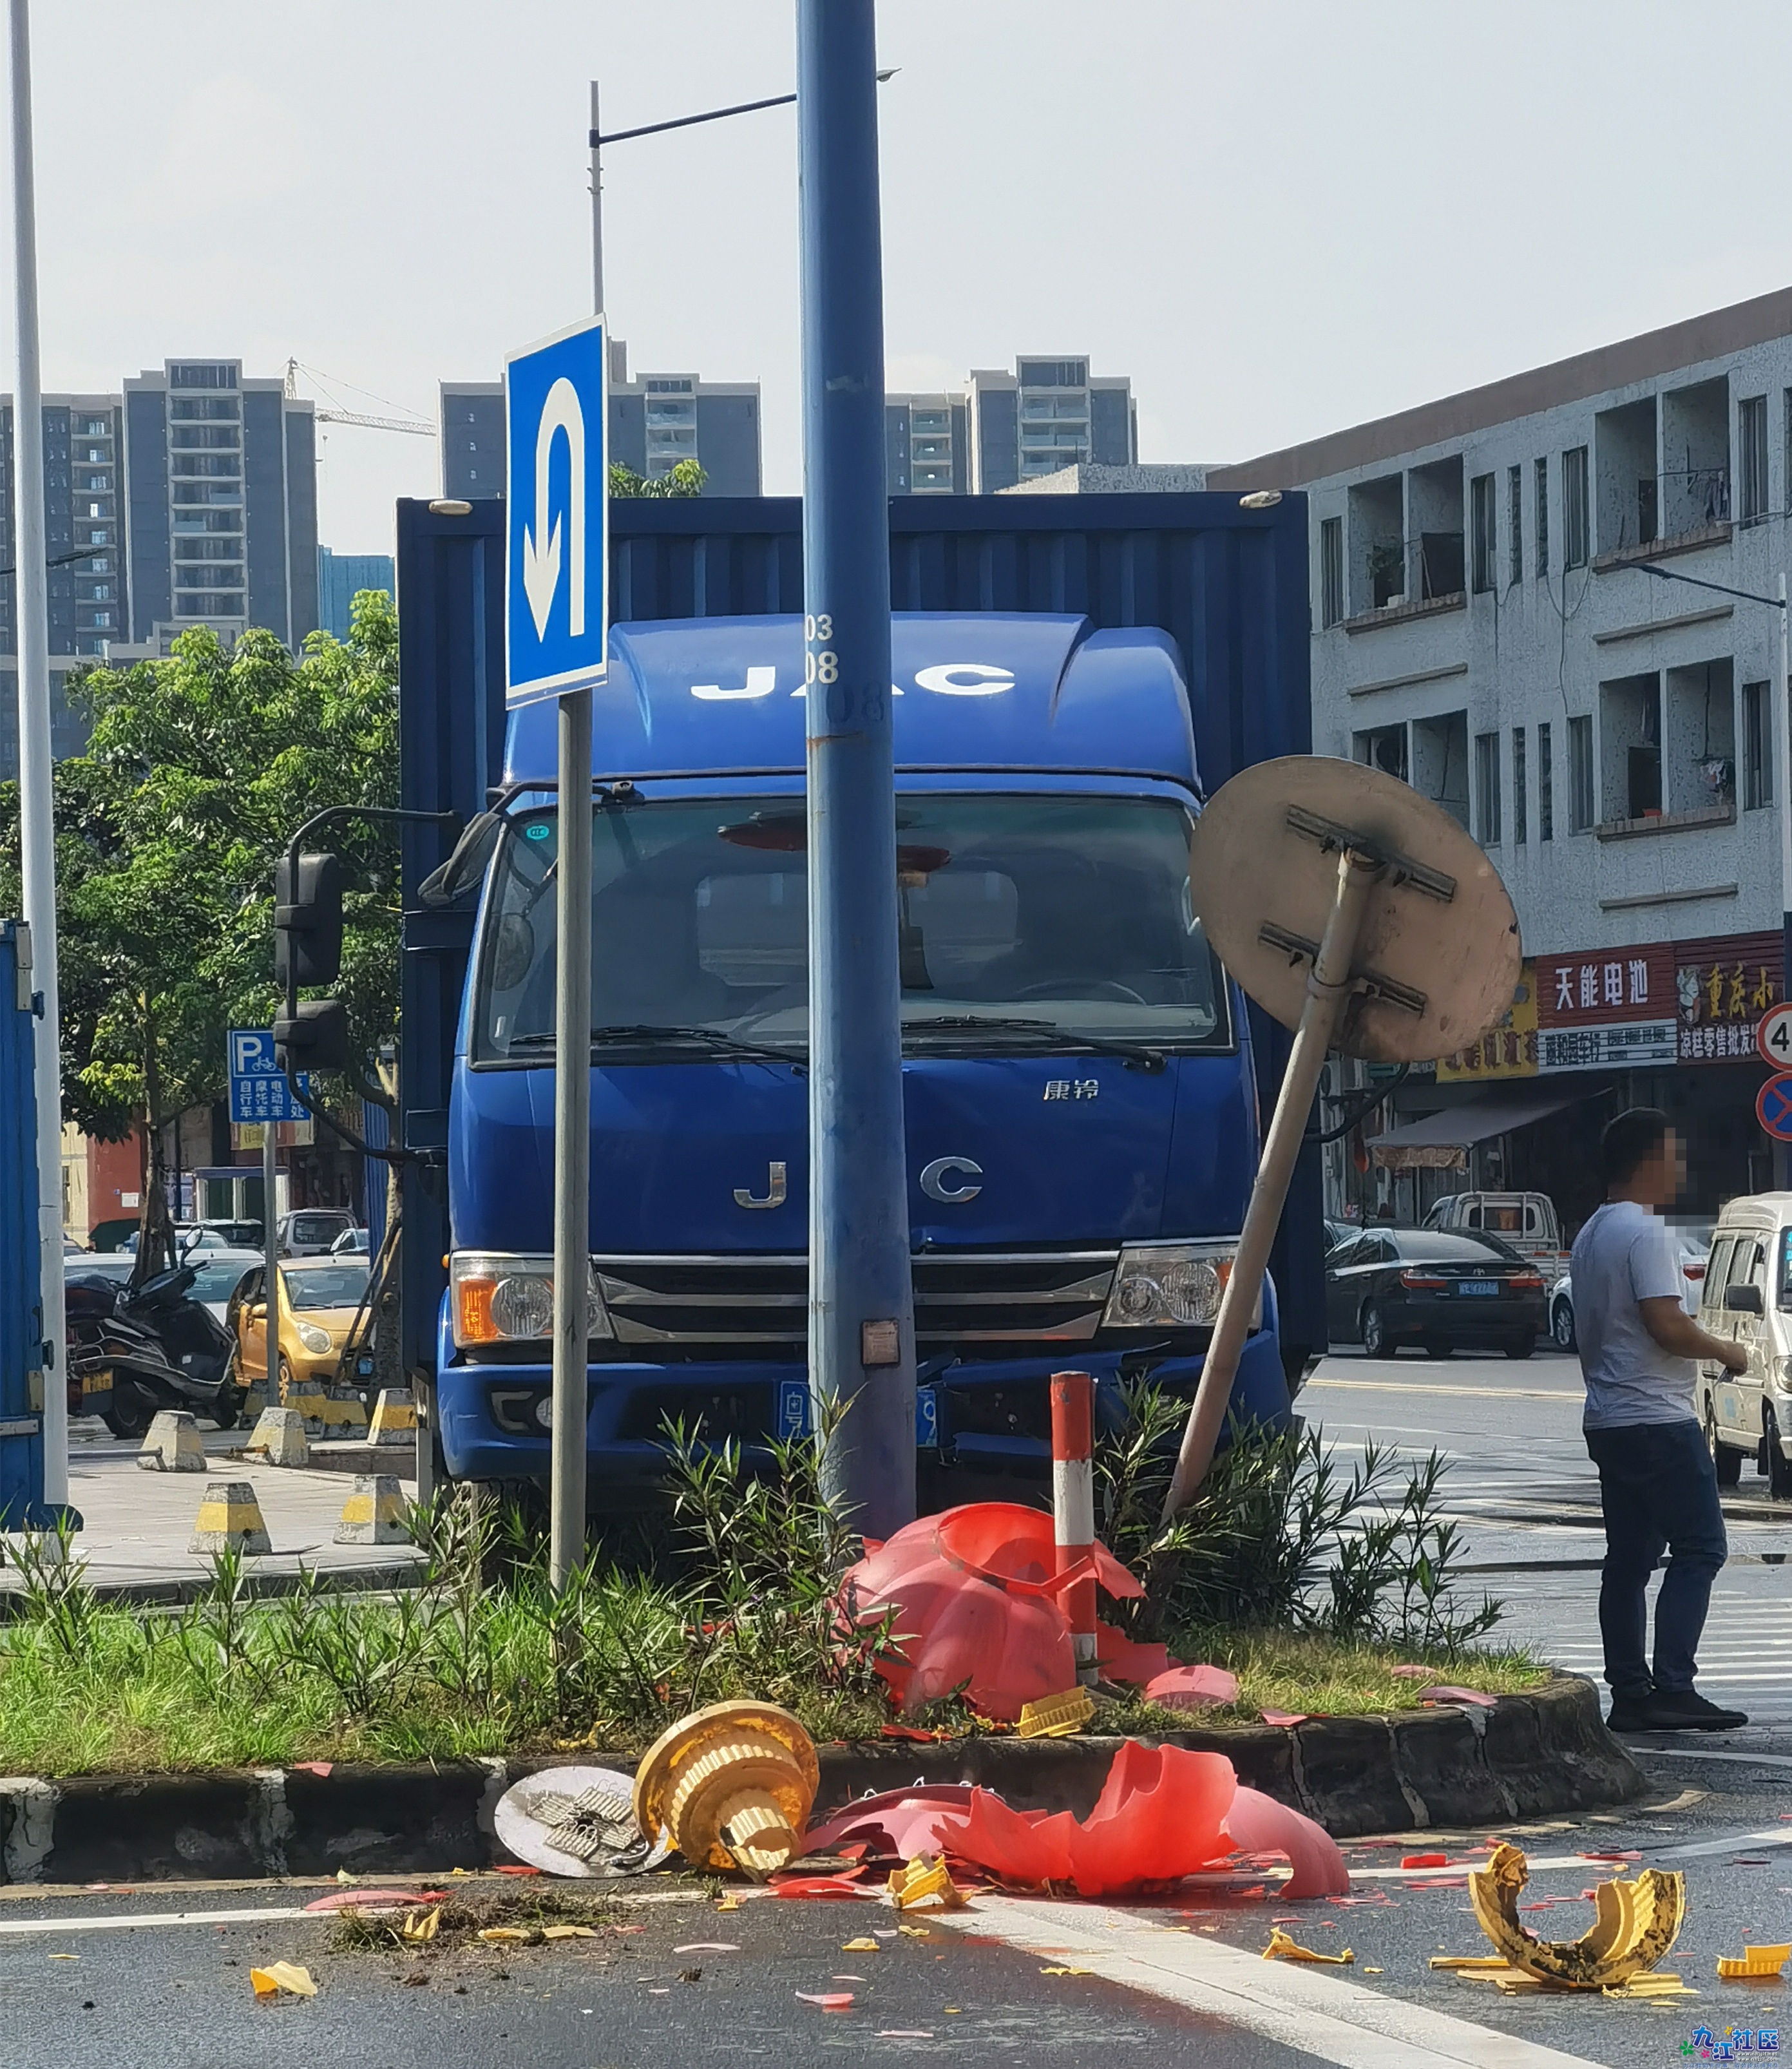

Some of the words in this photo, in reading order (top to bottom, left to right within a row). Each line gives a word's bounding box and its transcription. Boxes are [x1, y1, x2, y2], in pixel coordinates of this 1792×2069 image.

[1555, 959, 1648, 1011] 天能电池
[236, 1036, 262, 1073] P
[240, 1080, 253, 1118] 自行车
[254, 1080, 269, 1117] 摩托车
[270, 1080, 284, 1118] 电动车
[1043, 1078, 1100, 1101] 康铃
[733, 1156, 984, 1209] JC
